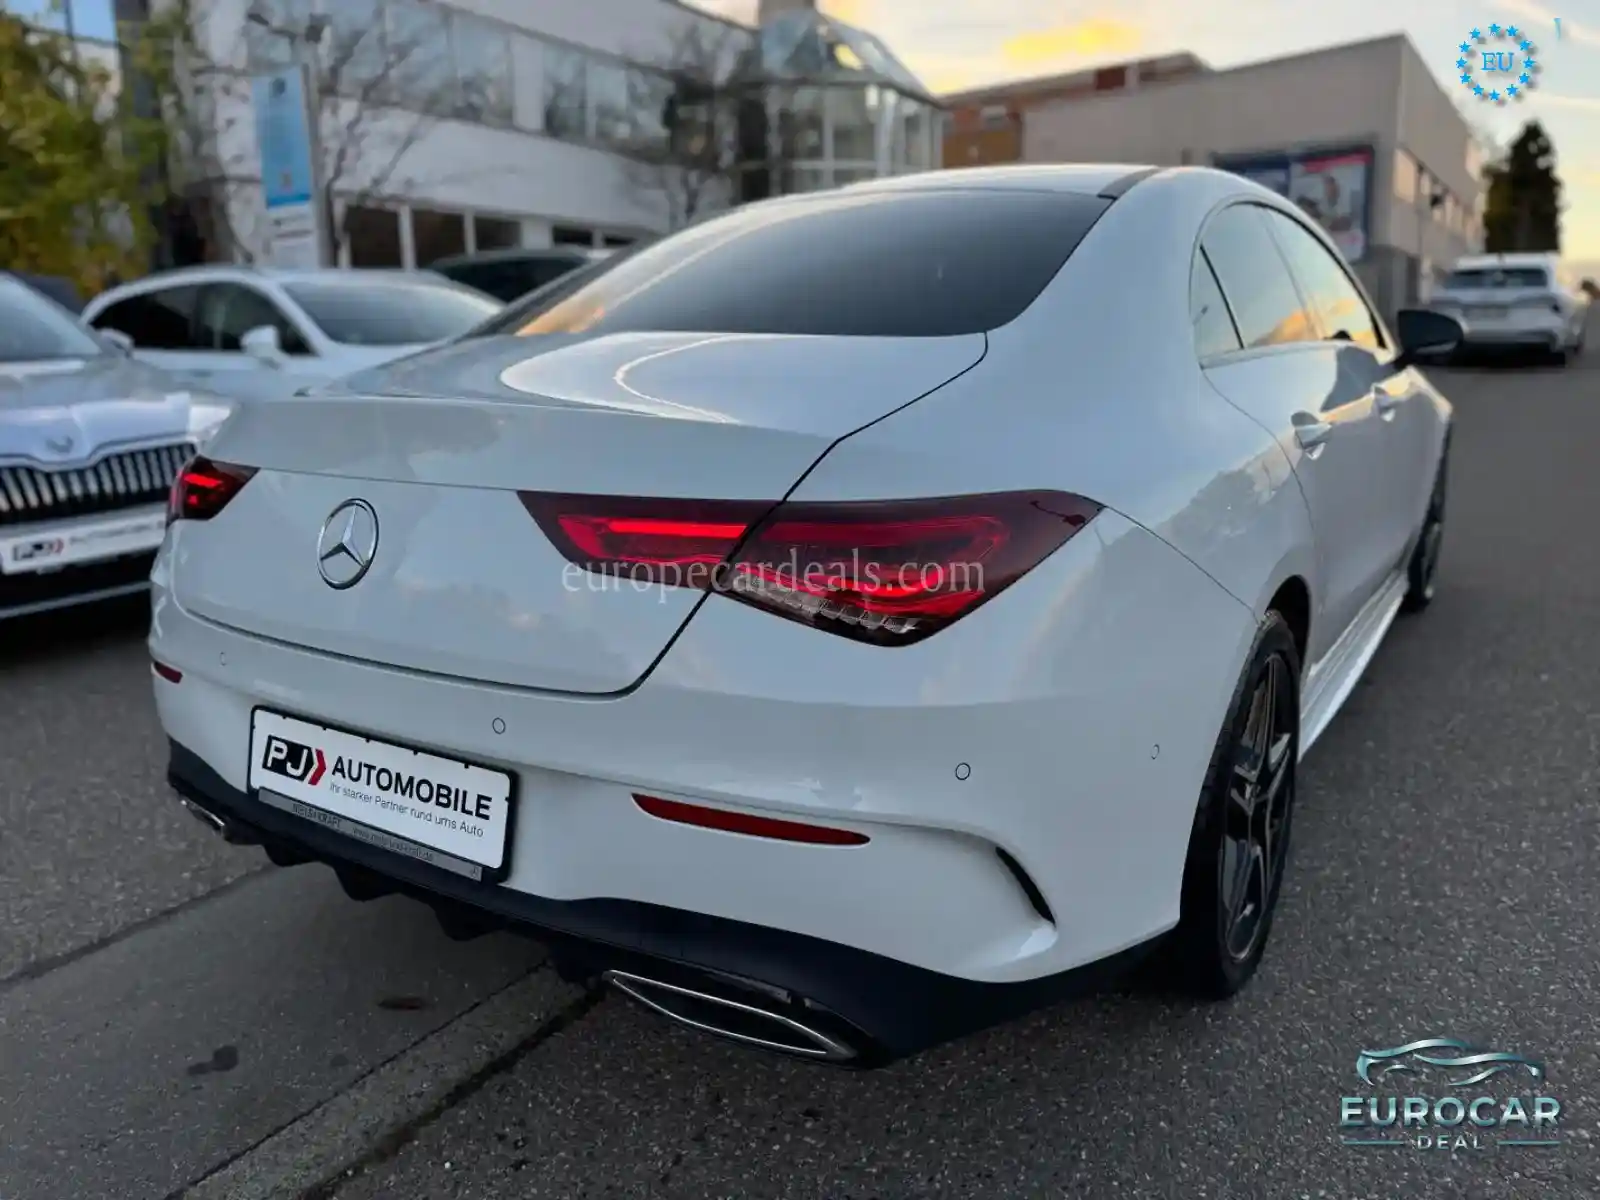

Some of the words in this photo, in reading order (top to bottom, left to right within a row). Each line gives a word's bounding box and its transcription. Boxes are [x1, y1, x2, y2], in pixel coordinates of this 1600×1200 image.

[266, 738, 309, 778] PJ
[332, 755, 493, 820] AUTOMOBILE
[343, 787, 373, 803] starker
[375, 796, 409, 814] Partner
[410, 808, 433, 822] rund
[435, 817, 457, 829] ums
[459, 821, 484, 838] Auto
